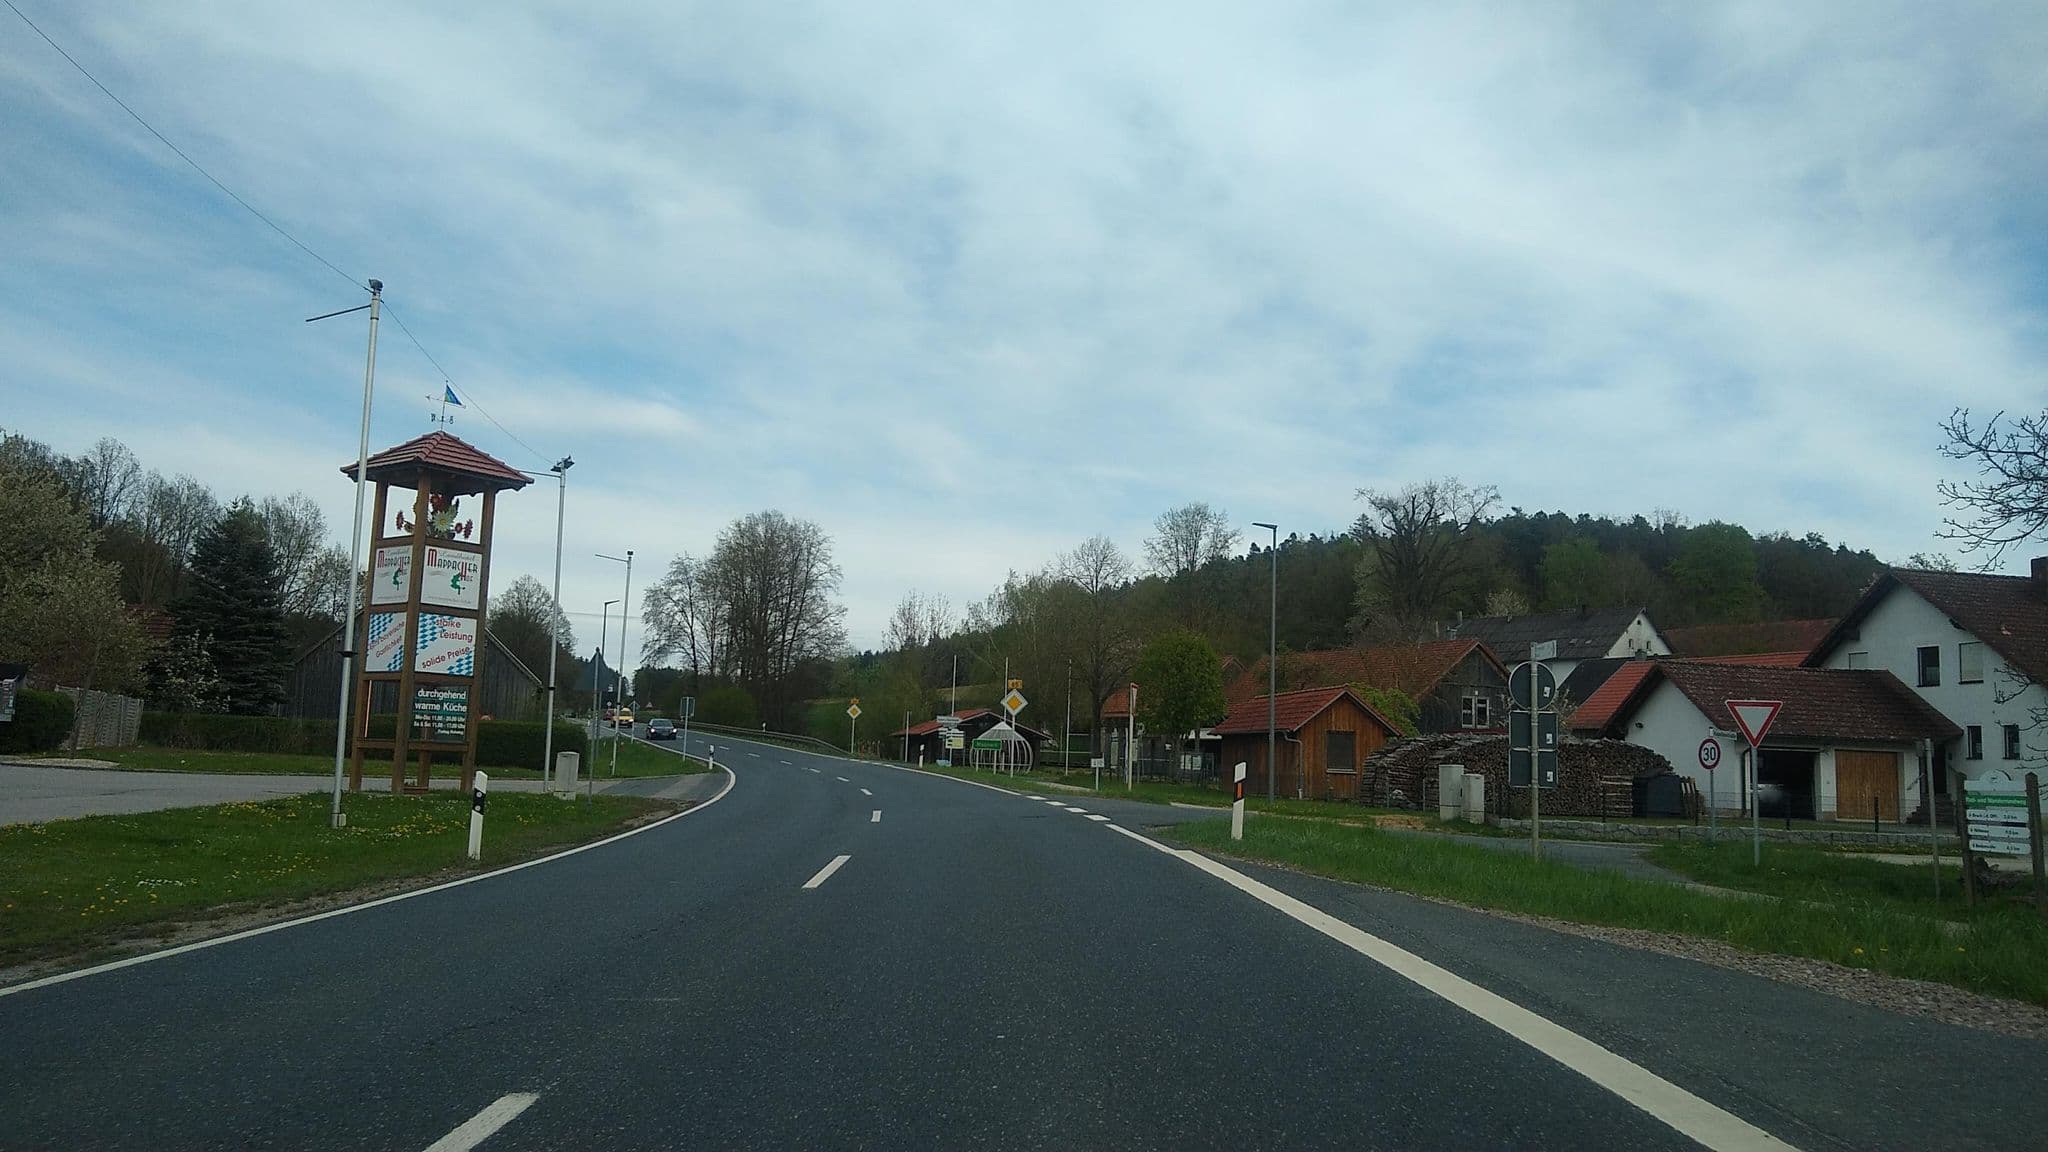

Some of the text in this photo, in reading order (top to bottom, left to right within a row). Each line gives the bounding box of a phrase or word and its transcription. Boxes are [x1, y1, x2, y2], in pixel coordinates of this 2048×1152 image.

[427, 549, 478, 579] MAPPACHER
[436, 619, 461, 629] starke
[440, 631, 473, 643] Leistung
[422, 646, 470, 669] solide Preise
[417, 688, 467, 701] durchgehend
[415, 702, 468, 712] warme Küche
[1703, 747, 1716, 761] 30
